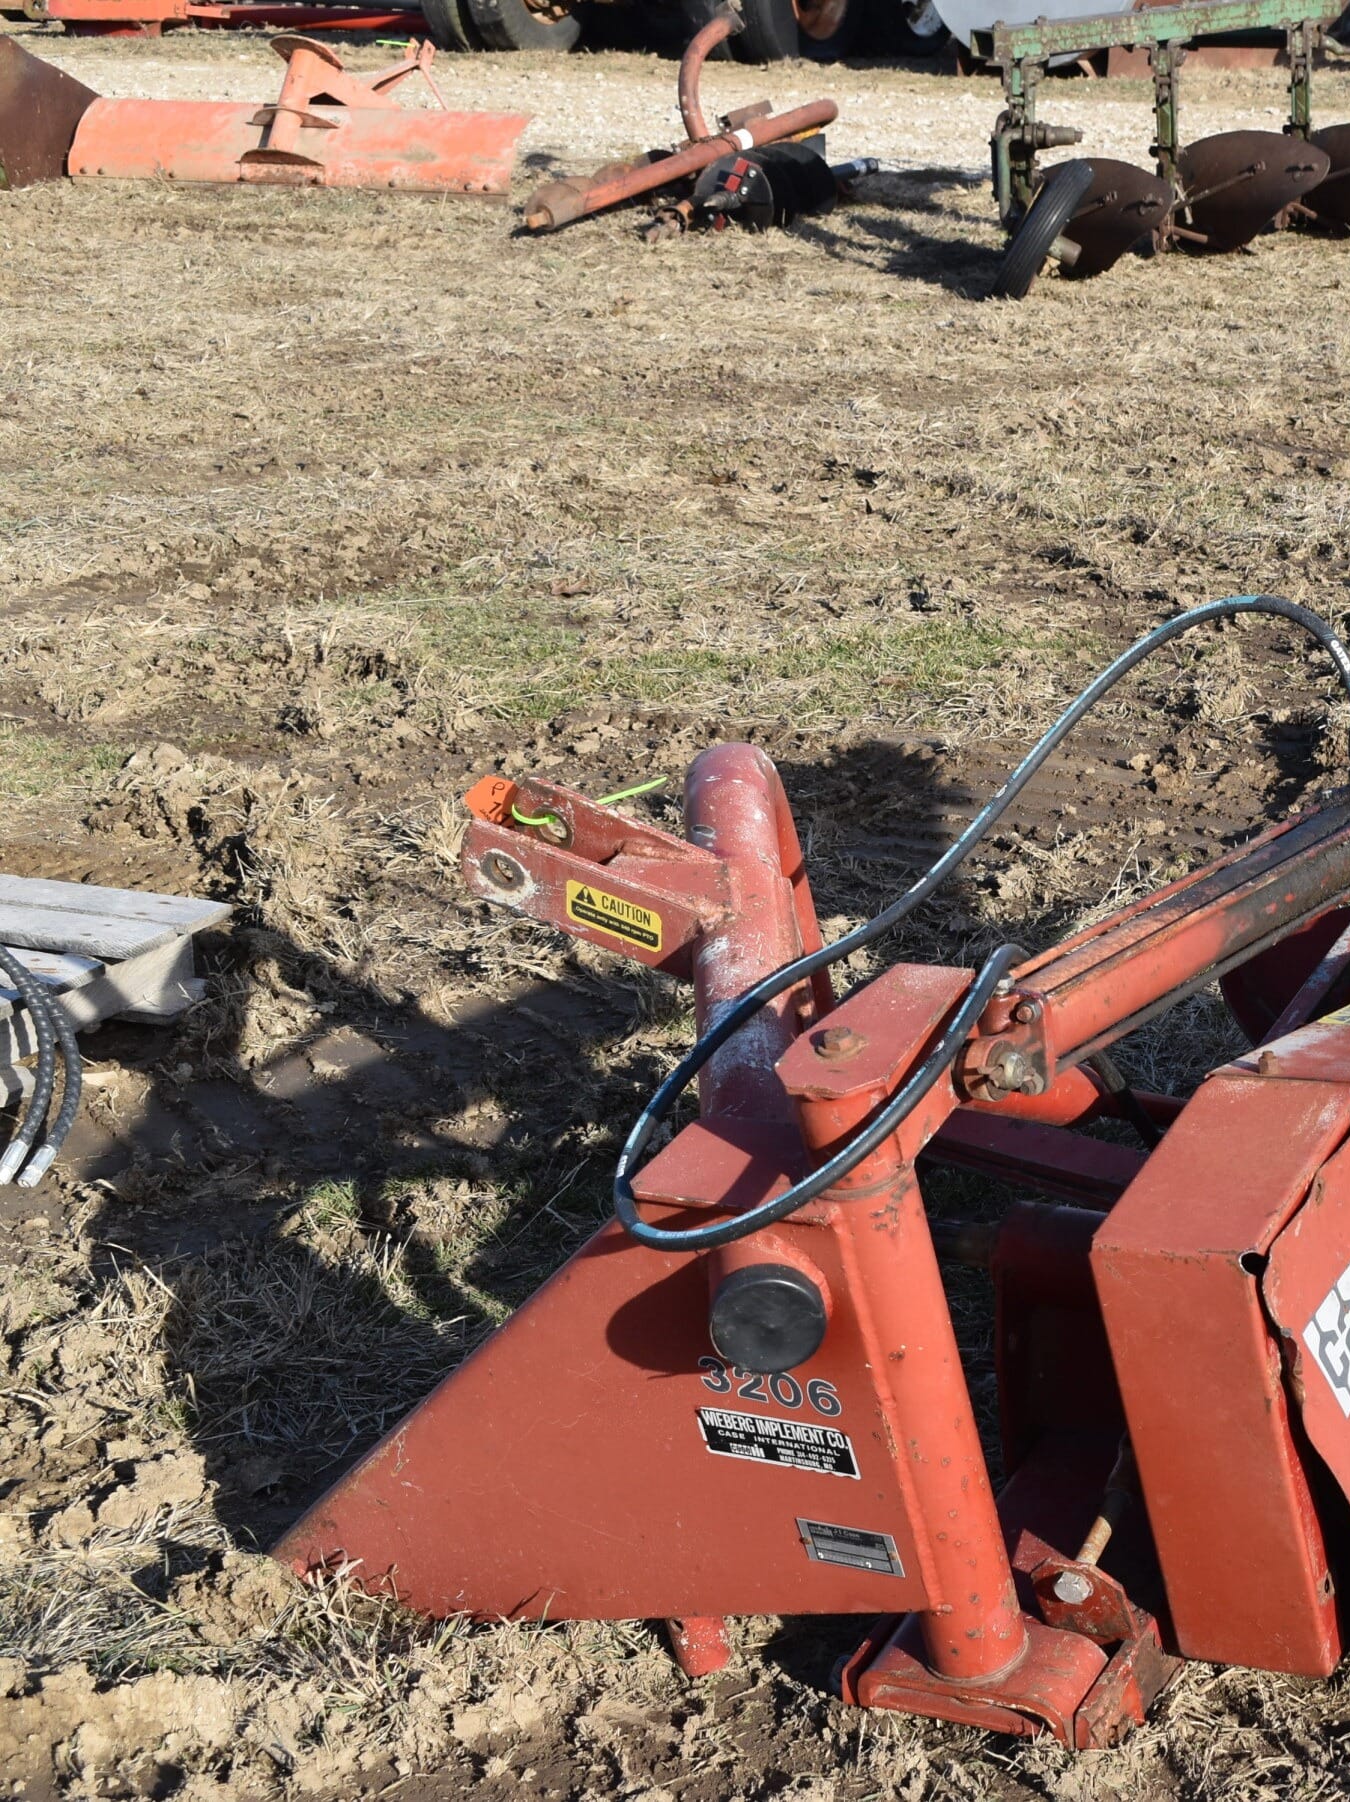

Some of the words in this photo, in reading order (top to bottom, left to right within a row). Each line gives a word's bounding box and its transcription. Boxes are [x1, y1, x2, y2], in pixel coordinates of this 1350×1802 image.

[575, 905, 596, 918] Operate
[608, 919, 620, 927] with
[601, 895, 651, 927] CAUTION
[698, 1356, 842, 1417] 3206
[701, 1410, 756, 1434] WIEBERG
[756, 1419, 825, 1446] IMPLEMENT
[825, 1430, 850, 1450] CO.
[718, 1429, 746, 1440] CASE
[753, 1435, 841, 1457] INTERNATIONAL
[776, 1447, 796, 1457] PHONE
